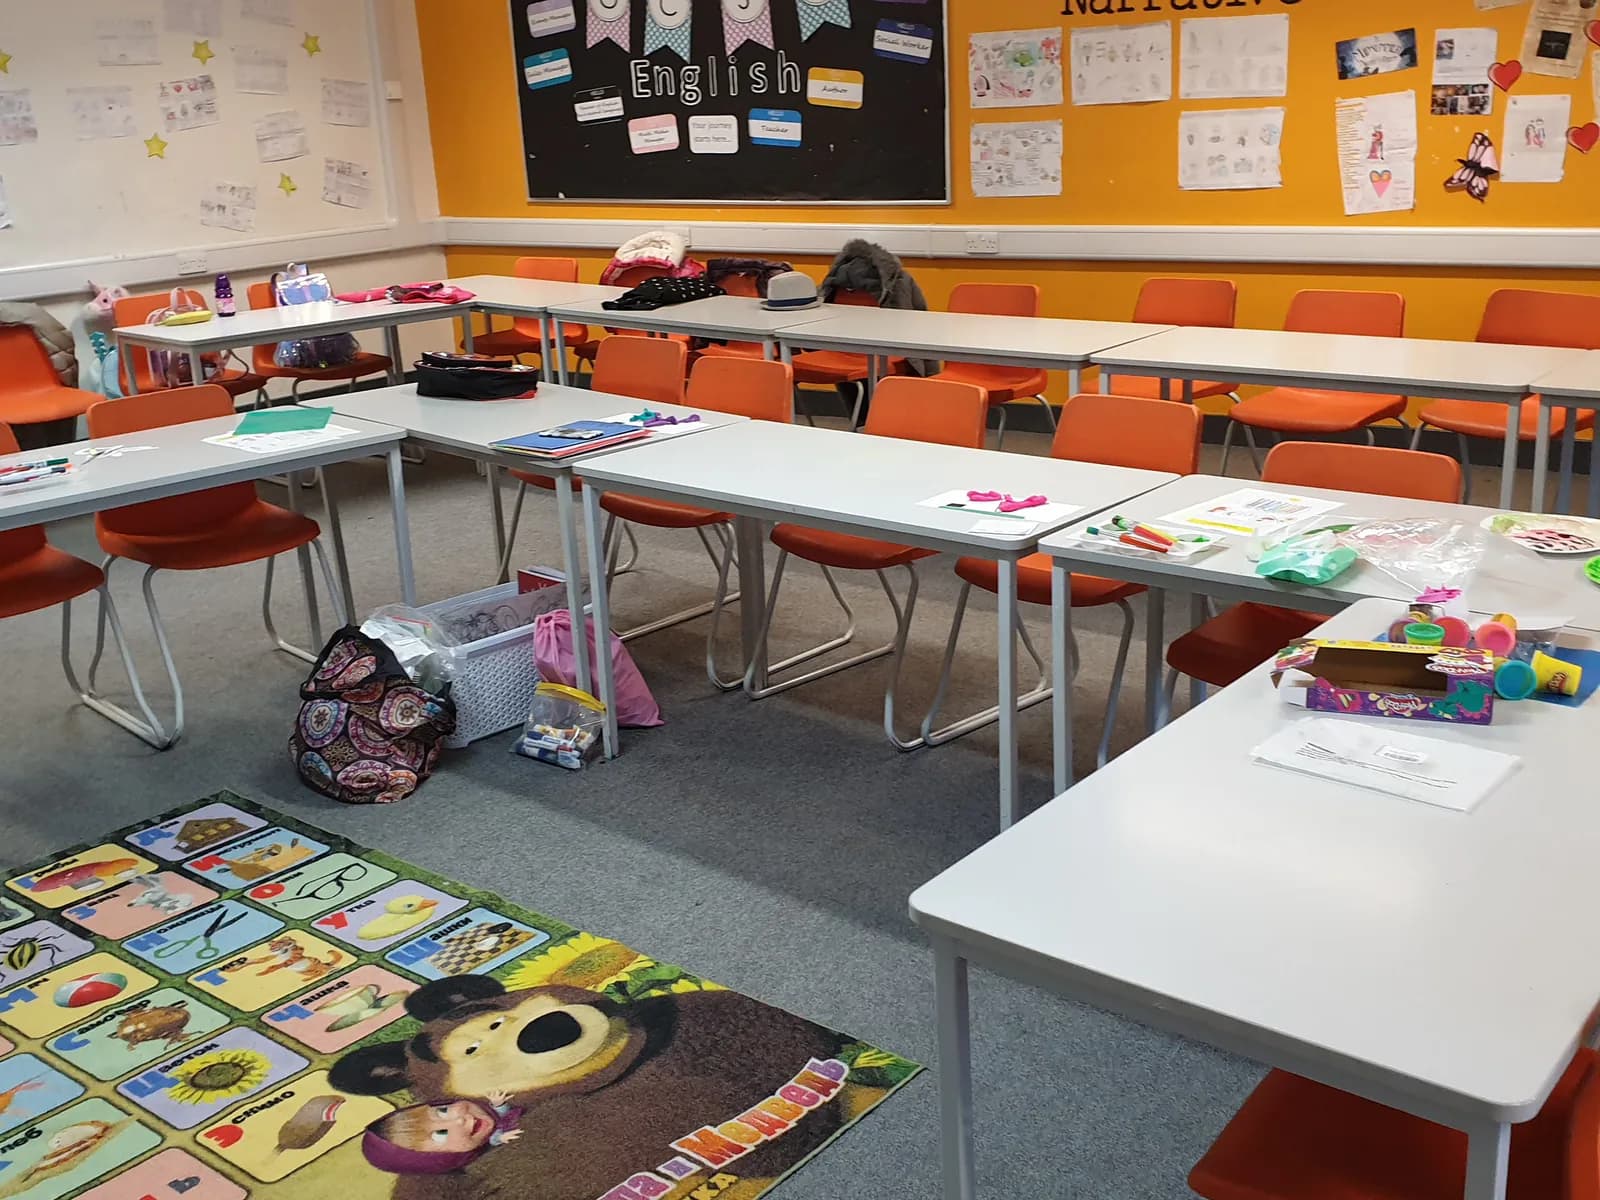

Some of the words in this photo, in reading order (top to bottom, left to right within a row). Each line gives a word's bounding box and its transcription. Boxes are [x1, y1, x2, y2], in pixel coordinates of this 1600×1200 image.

[630, 50, 801, 105] English
[316, 899, 376, 930] Утка
[387, 917, 473, 966] Шашки
[194, 957, 248, 986] Тигр
[268, 980, 350, 1022] Чашка
[203, 1091, 295, 1148] Эскимо
[0, 1127, 43, 1171] леб
